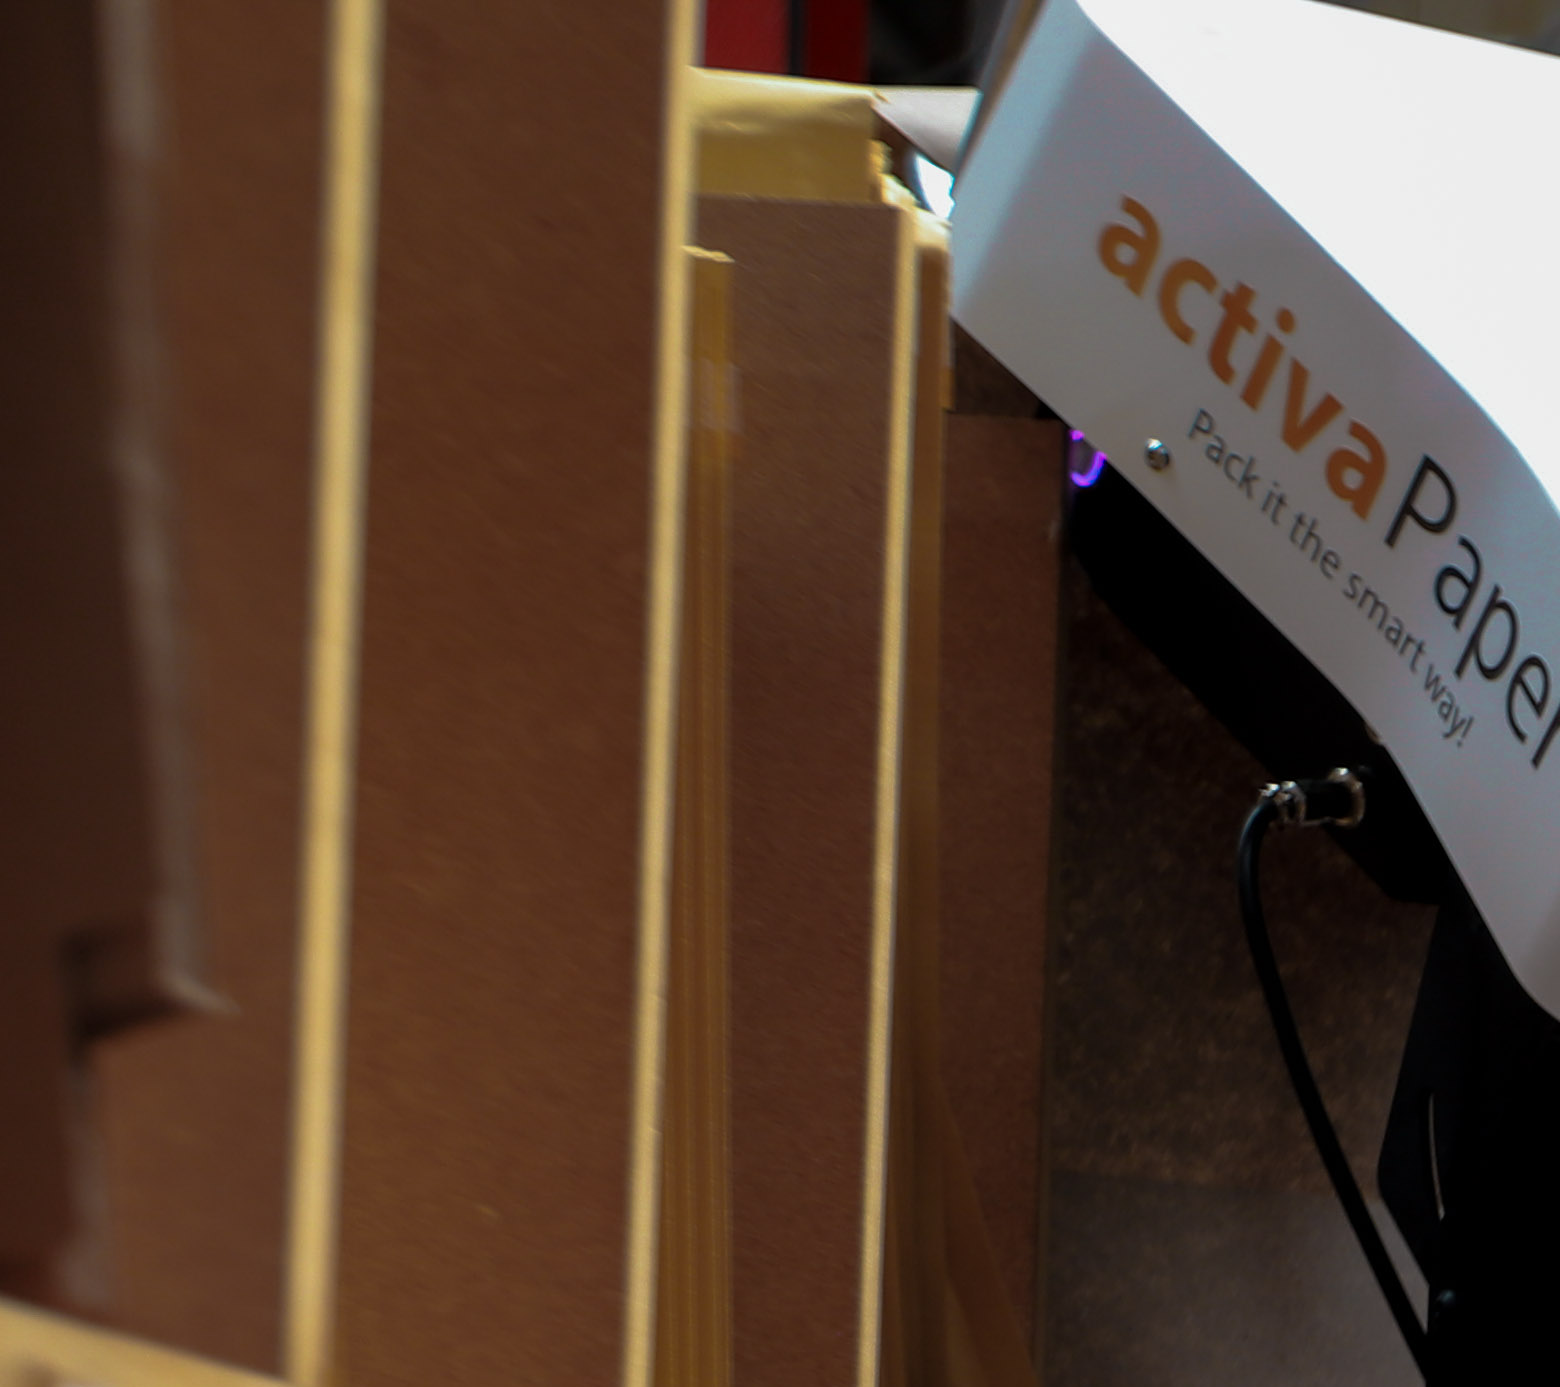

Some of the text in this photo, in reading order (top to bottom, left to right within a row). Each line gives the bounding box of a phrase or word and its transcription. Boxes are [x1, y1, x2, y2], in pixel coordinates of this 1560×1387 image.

[1187, 408, 1474, 748] Pack it the smart way!
